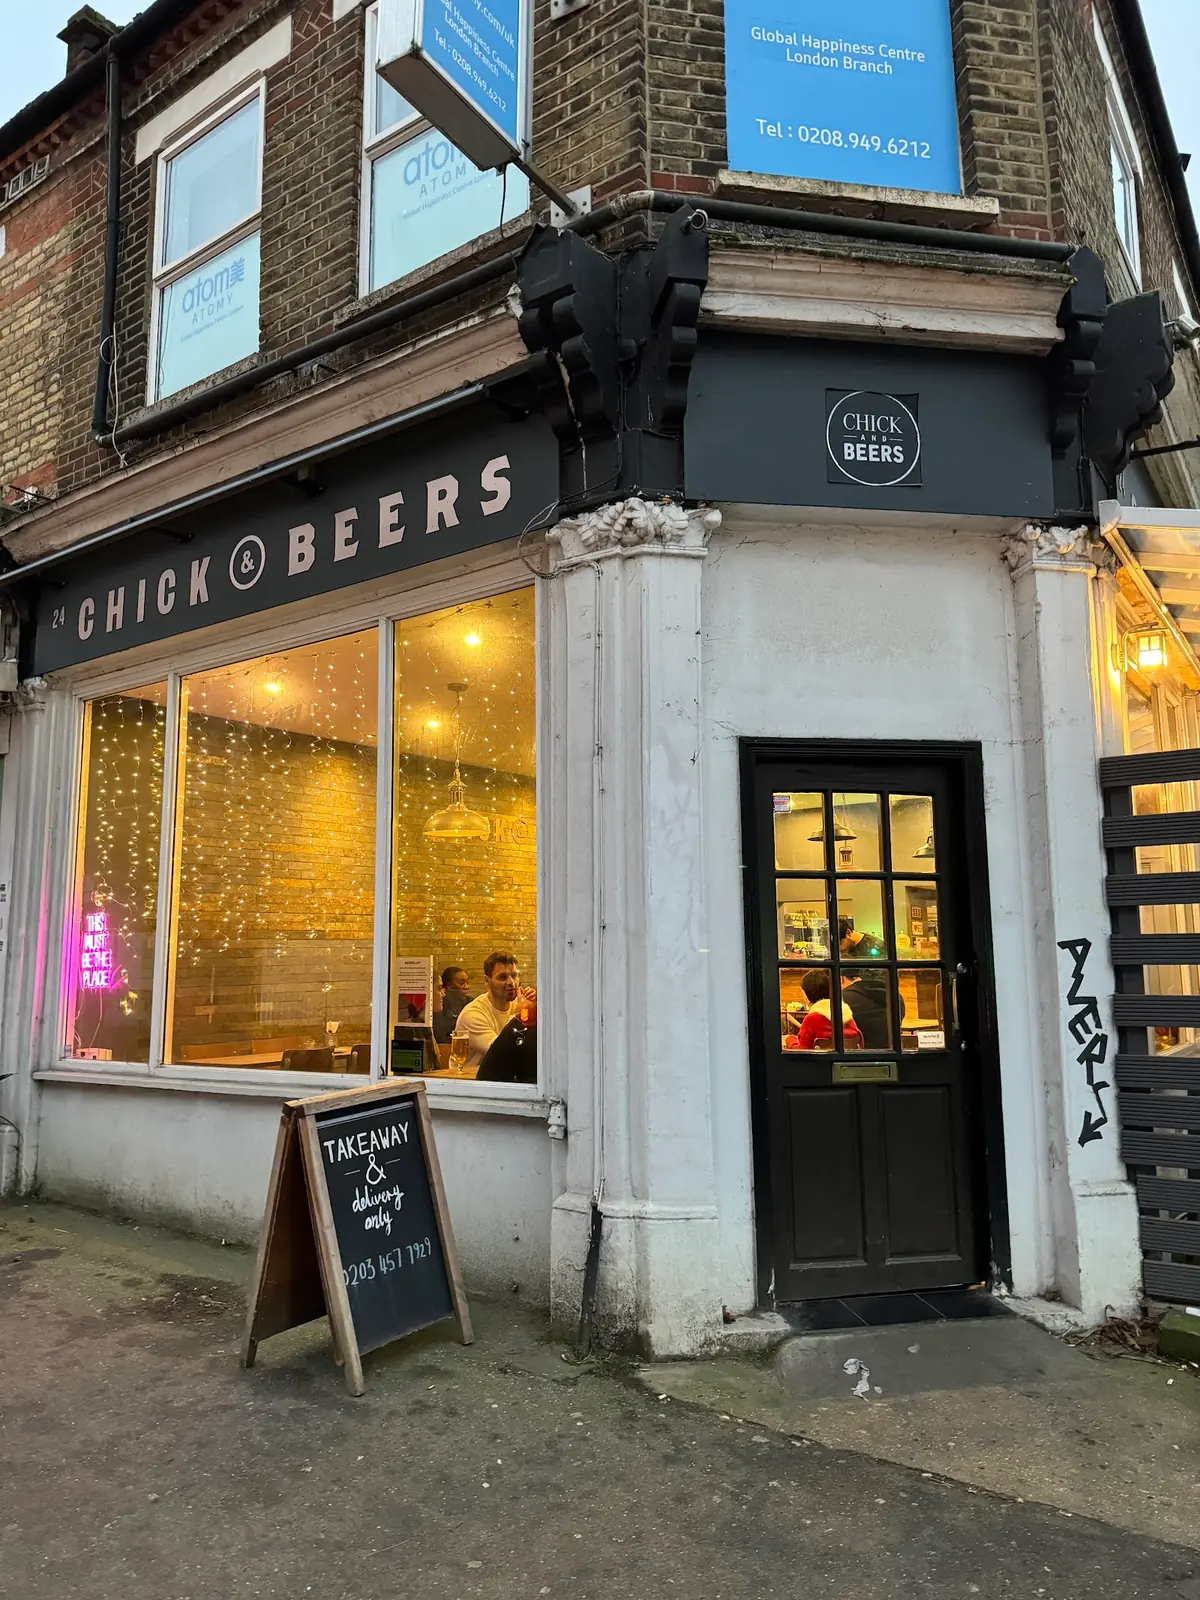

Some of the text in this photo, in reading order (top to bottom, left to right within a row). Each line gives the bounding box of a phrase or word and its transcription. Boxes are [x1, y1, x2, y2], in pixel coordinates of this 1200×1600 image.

[472, 0, 515, 48] y.com/uk
[445, 10, 499, 77] London Branch
[453, 6, 491, 55] Happiness
[492, 50, 515, 81] Centre
[751, 26, 925, 63] Global Happiness Centre
[786, 48, 893, 75] London Branch
[434, 28, 447, 49] Tel
[452, 48, 507, 112] 0208.949.6212
[755, 118, 783, 138] Tel
[798, 126, 931, 159] 0208.949.6212
[419, 162, 476, 198] ATOM
[192, 292, 234, 326] ATOMY
[843, 412, 903, 434] CHICK
[860, 434, 887, 442] AND
[843, 442, 904, 463] BEERS
[51, 454, 511, 640] 24 CHICK & BEERS
[82, 970, 110, 986] PLACE
[323, 1121, 409, 1163] TAKEAWAY
[366, 1153, 387, 1185] &
[352, 1184, 405, 1212] delivery
[364, 1206, 393, 1236] only
[379, 1248, 402, 1274] 457
[406, 1236, 431, 1264] 7929
